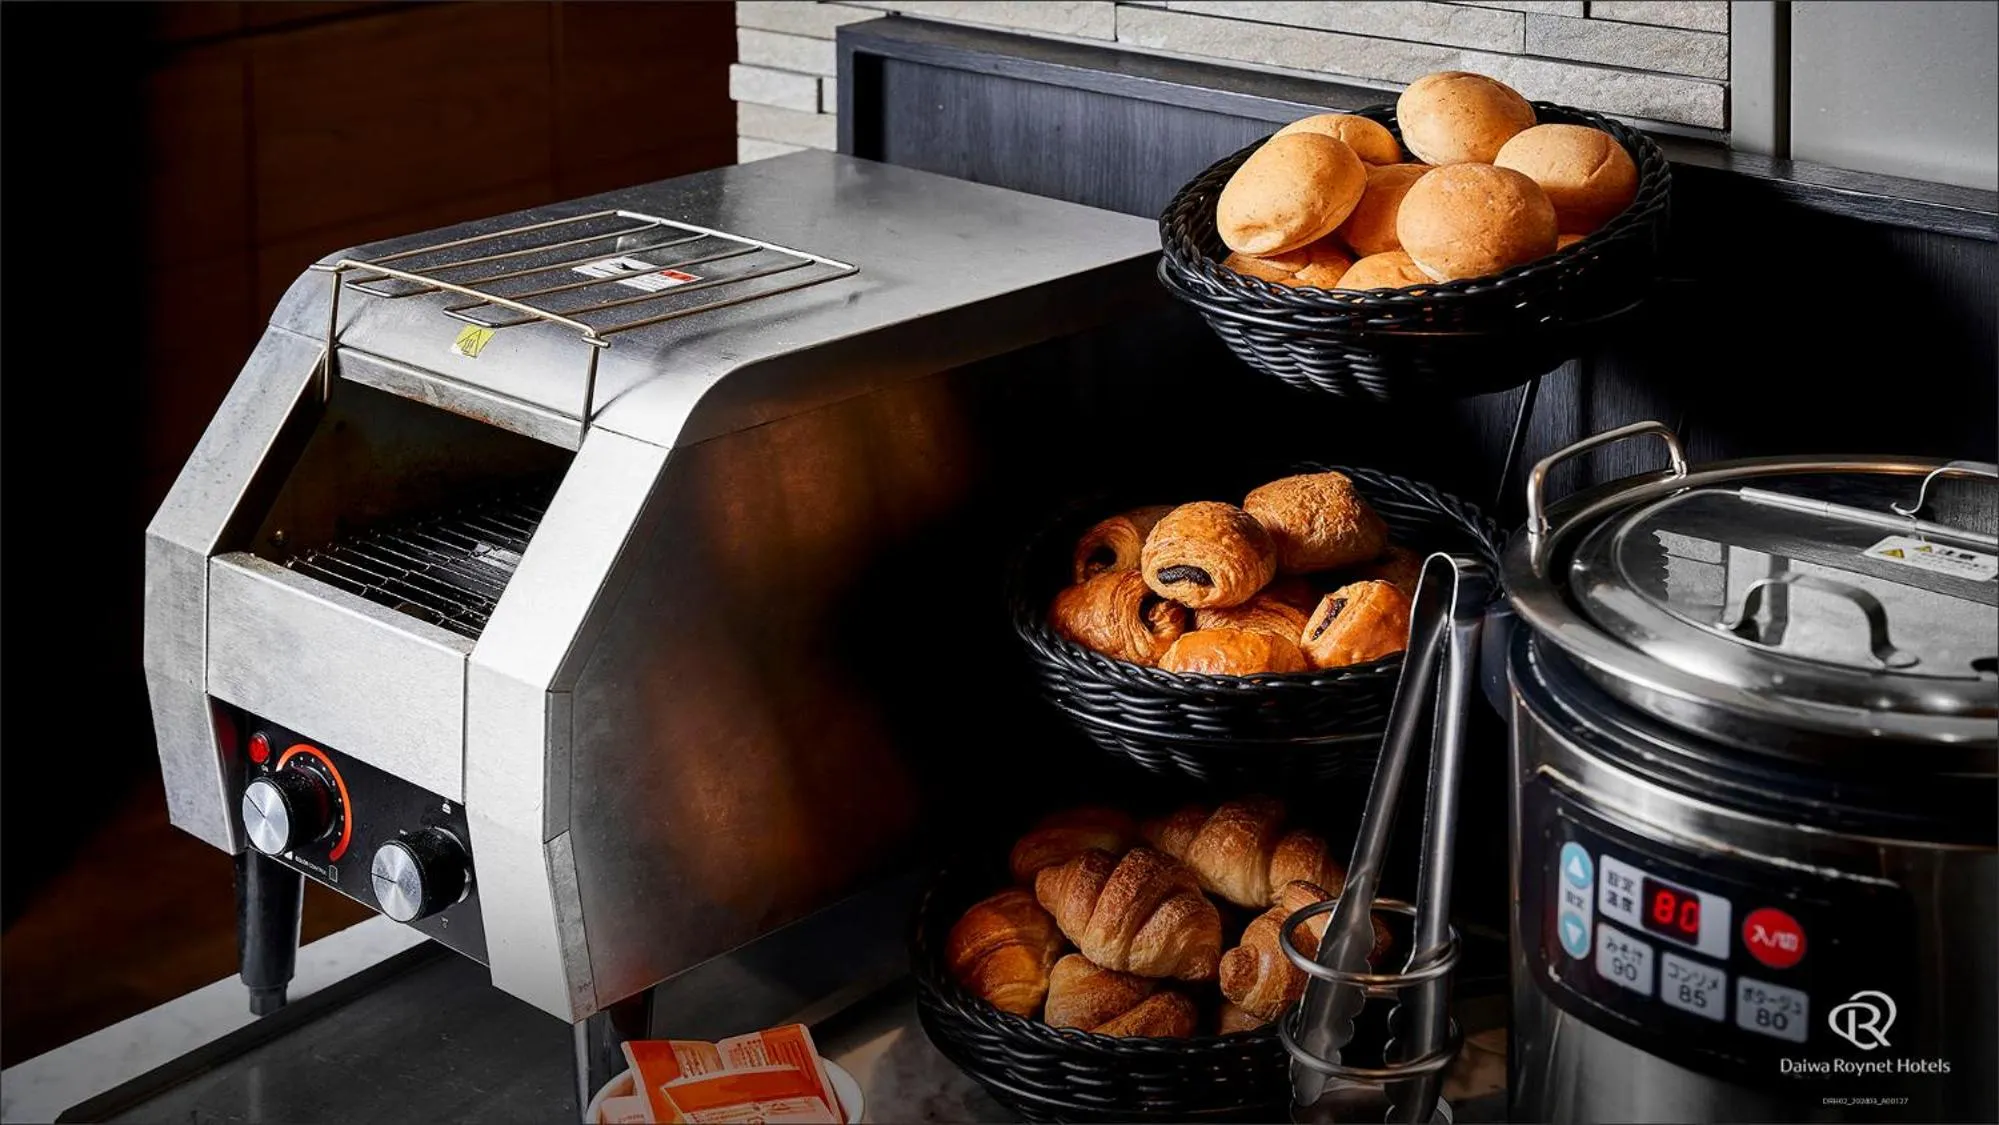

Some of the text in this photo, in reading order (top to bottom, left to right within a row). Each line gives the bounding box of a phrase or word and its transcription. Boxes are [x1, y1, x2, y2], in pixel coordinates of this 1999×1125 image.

[1653, 890, 1700, 934] 80
[1612, 956, 1638, 982] 90
[1679, 983, 1708, 1009] 85
[1755, 1007, 1789, 1032] 80
